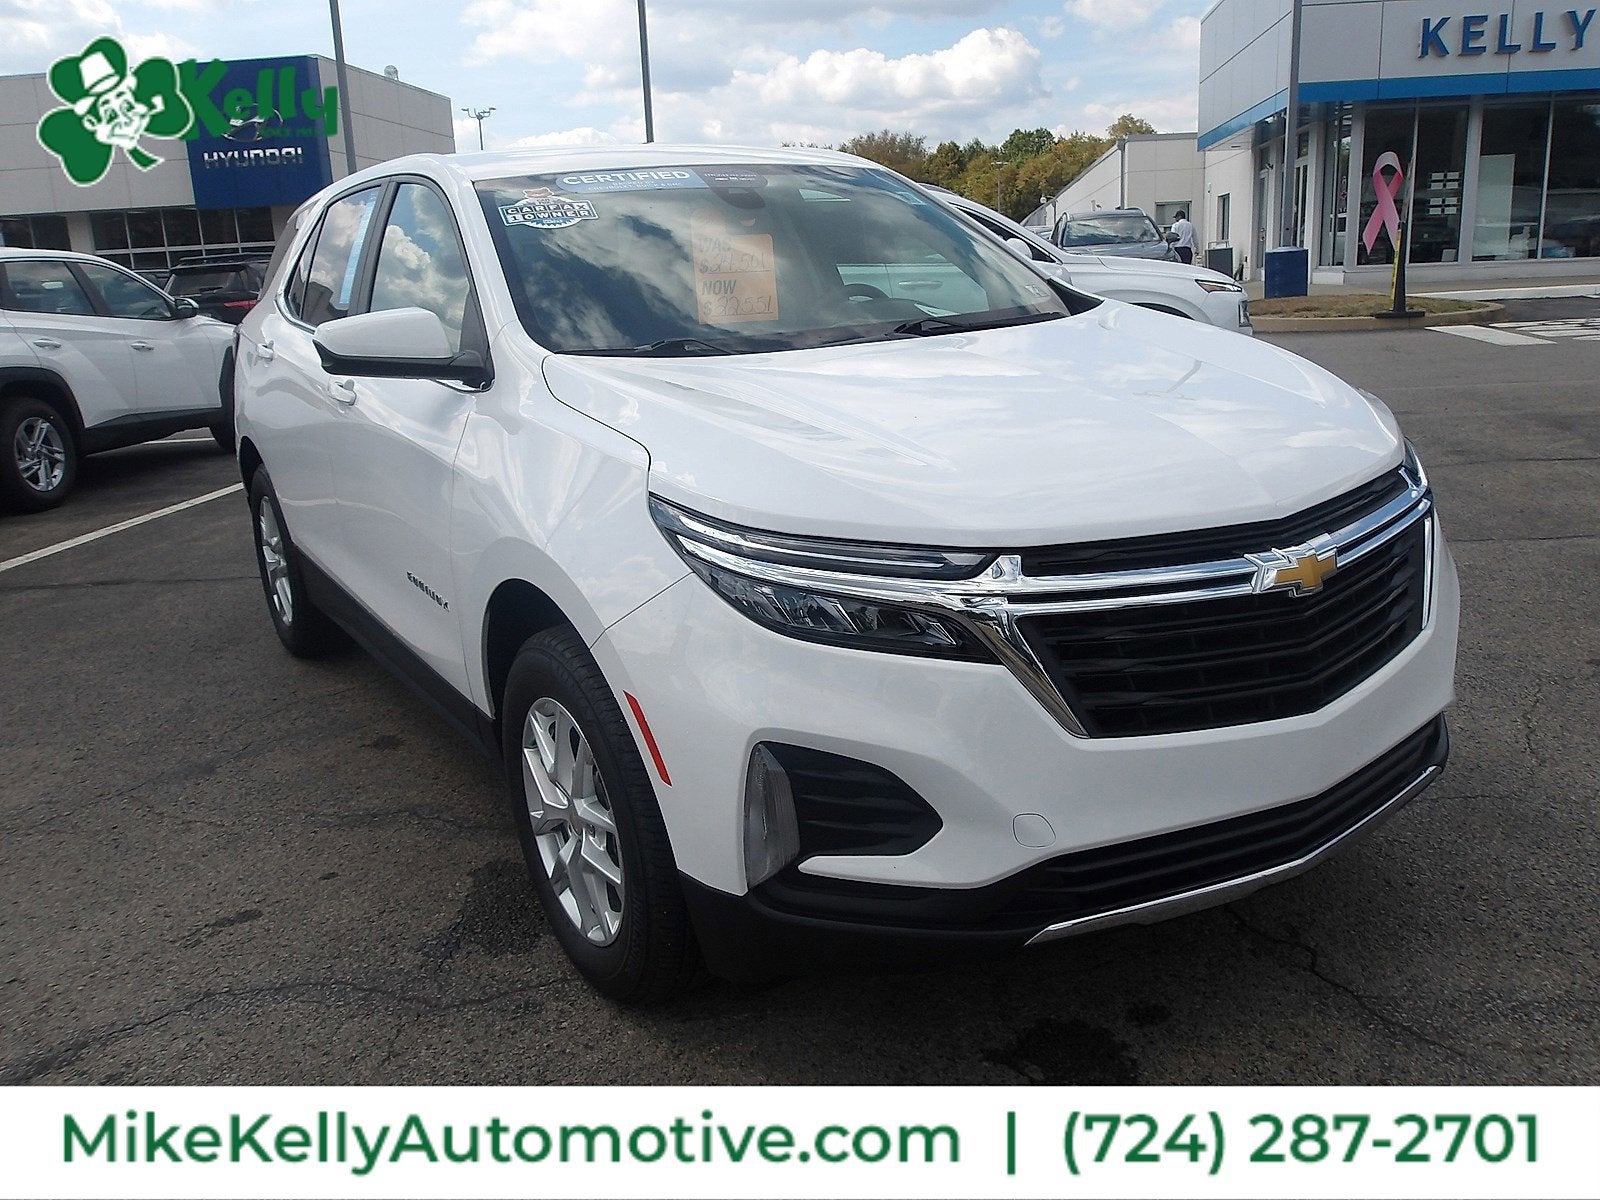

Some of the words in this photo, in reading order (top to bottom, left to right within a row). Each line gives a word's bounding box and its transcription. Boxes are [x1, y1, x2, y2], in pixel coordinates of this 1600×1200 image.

[1418, 9, 1597, 59] KELLY
[203, 146, 304, 169] HYUNDAI
[562, 171, 691, 185] CERTIFIED
[507, 203, 588, 214] CARFAX
[702, 279, 737, 295] NOW
